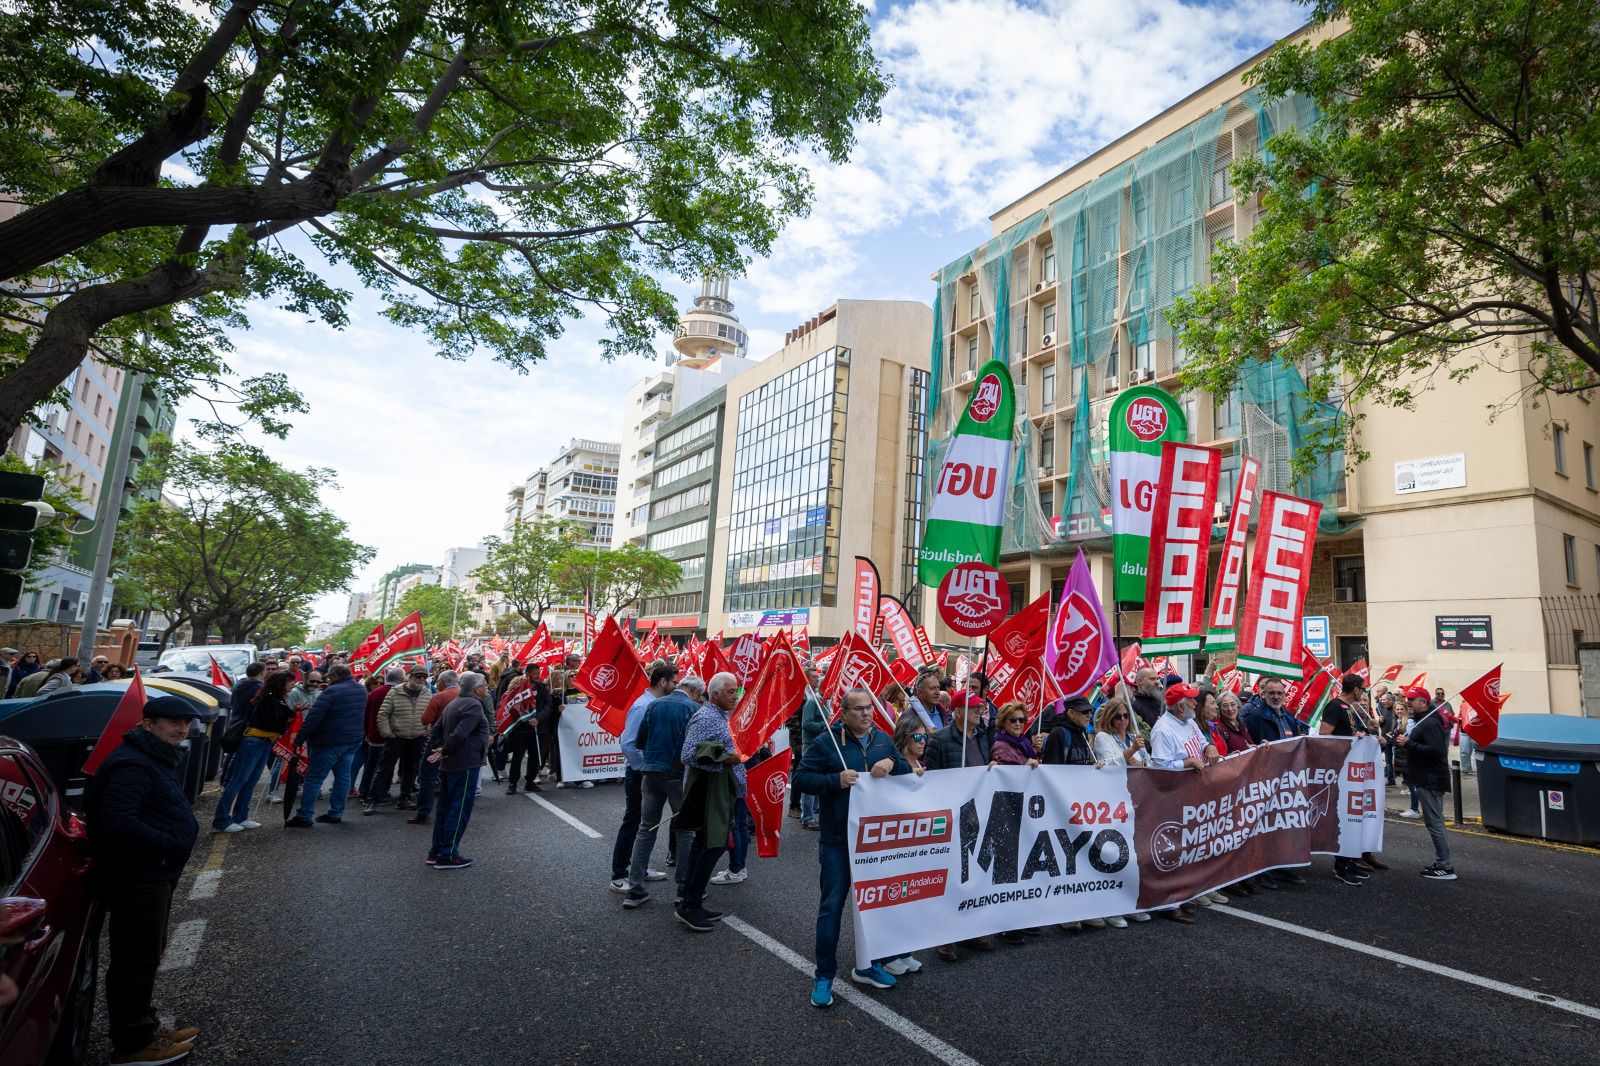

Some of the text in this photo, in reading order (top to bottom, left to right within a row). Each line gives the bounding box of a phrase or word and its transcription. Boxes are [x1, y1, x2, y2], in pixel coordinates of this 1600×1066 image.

[1132, 404, 1162, 425] UGT
[1156, 446, 1210, 636] CCOO
[1214, 459, 1257, 626] CCOO
[948, 569, 1000, 600] UGT
[1254, 496, 1309, 663] CCOO
[1006, 634, 1026, 652] UGT
[593, 666, 614, 687] UGT
[838, 653, 868, 693] UGT
[577, 731, 616, 748] CONTRA
[582, 766, 618, 776] servicios
[585, 755, 617, 766] CCOO
[1350, 766, 1365, 779] UG
[1068, 801, 1129, 825] 2024
[1182, 800, 1217, 826] POR
[1219, 793, 1233, 819] EL
[1234, 778, 1279, 807] PLENO
[861, 817, 932, 844] CCOO
[1181, 812, 1234, 848] MENOS
[854, 845, 951, 865] unión provincial de Cádiz
[1178, 828, 1250, 867] MEJORES
[854, 874, 944, 906] UGT Andalucía
[958, 879, 1124, 912] #PLENOEMPLEO / #1MAYO2024
